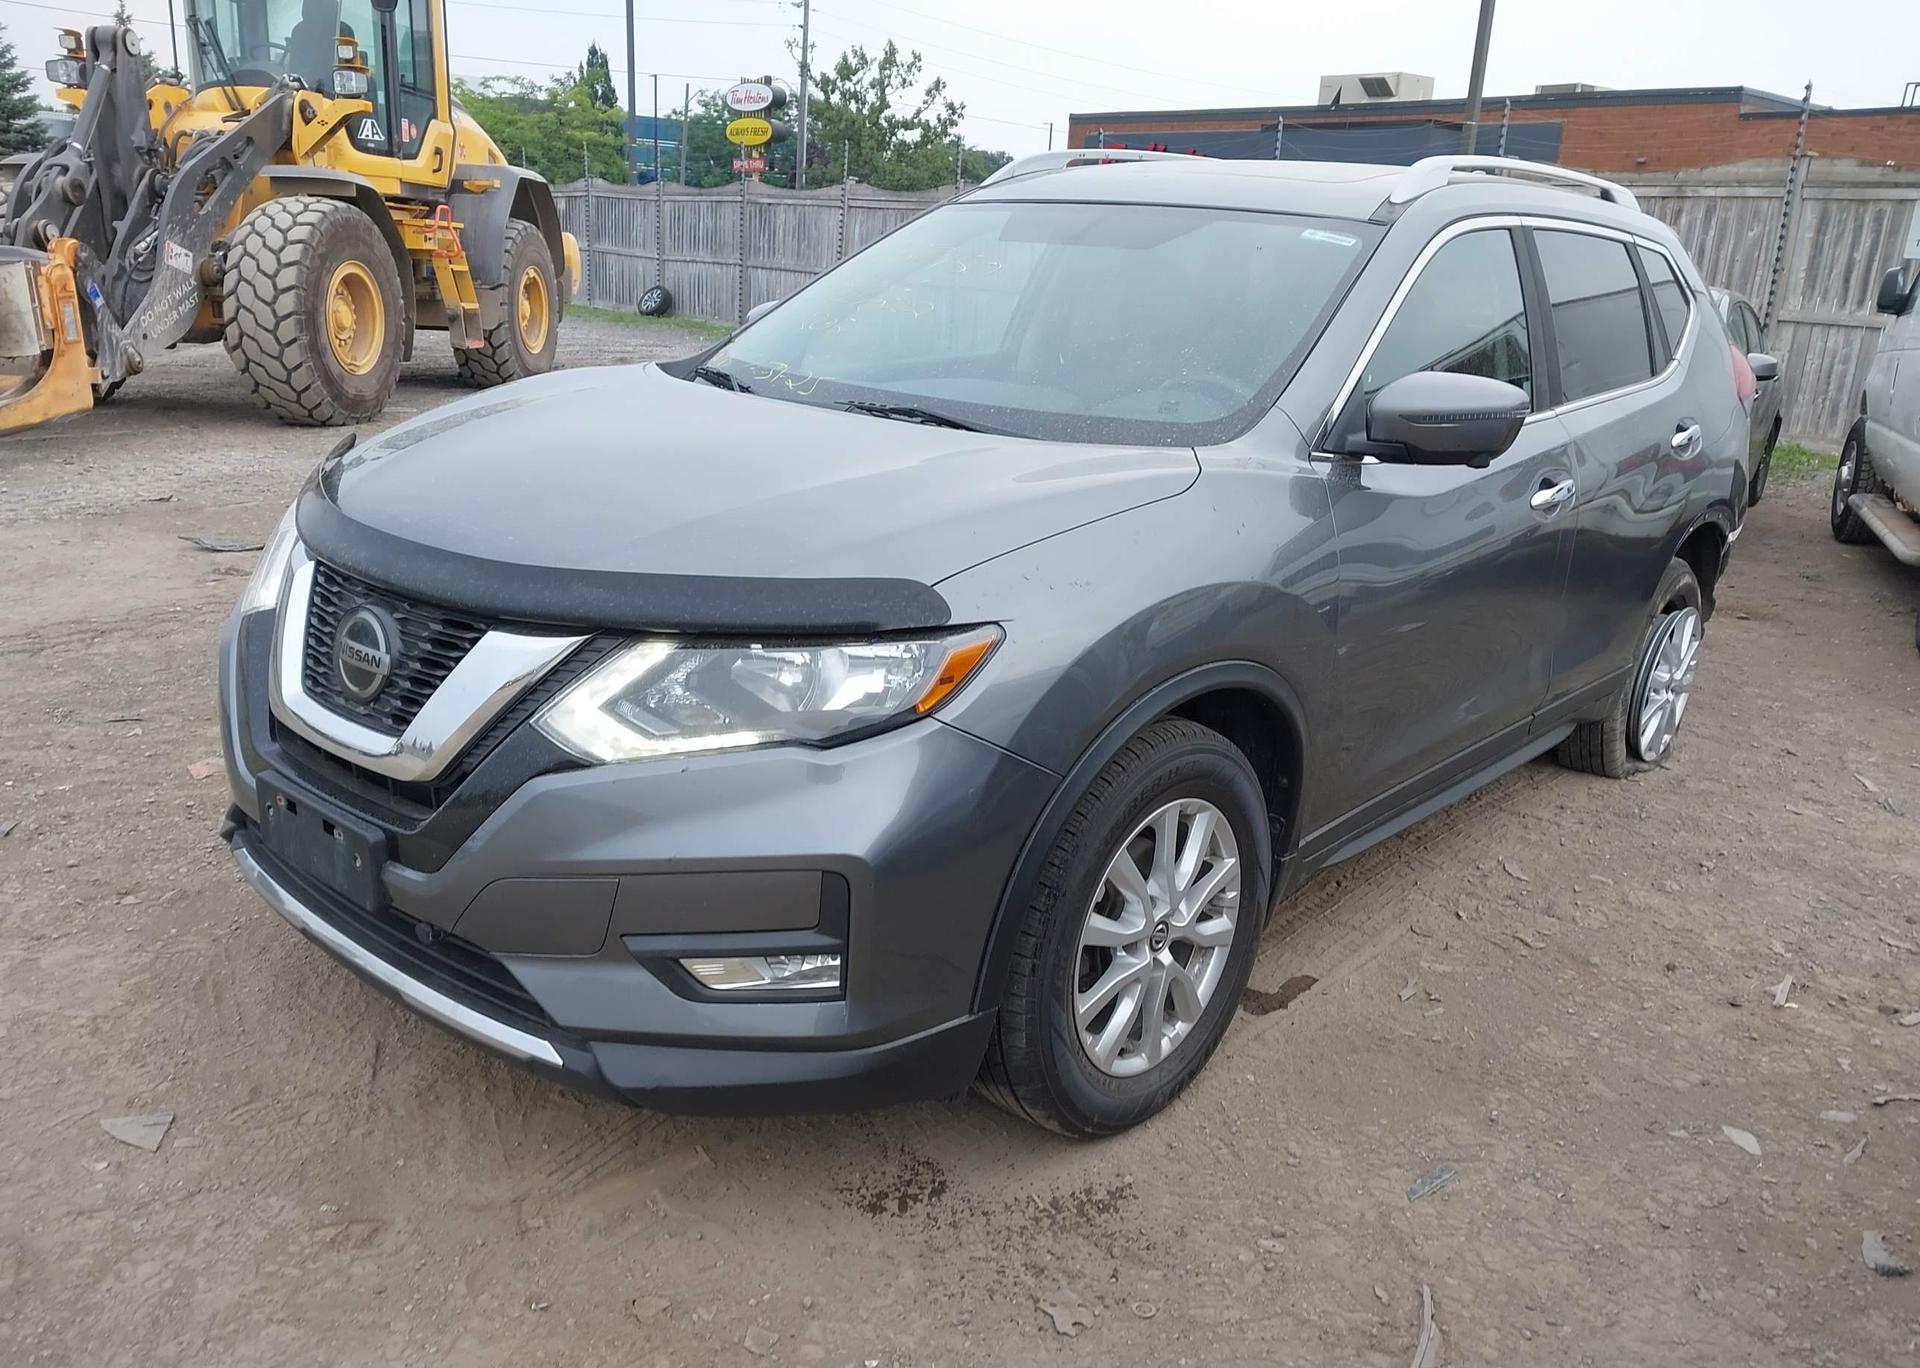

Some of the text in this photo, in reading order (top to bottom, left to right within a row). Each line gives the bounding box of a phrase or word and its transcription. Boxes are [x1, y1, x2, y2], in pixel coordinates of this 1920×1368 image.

[730, 89, 769, 105] Tim Hortons
[729, 126, 769, 137] ALWAYS FRESH
[140, 277, 197, 327] DO NOT WALK
[150, 291, 200, 338] UNDER MAST
[341, 642, 382, 669] NISSAN
